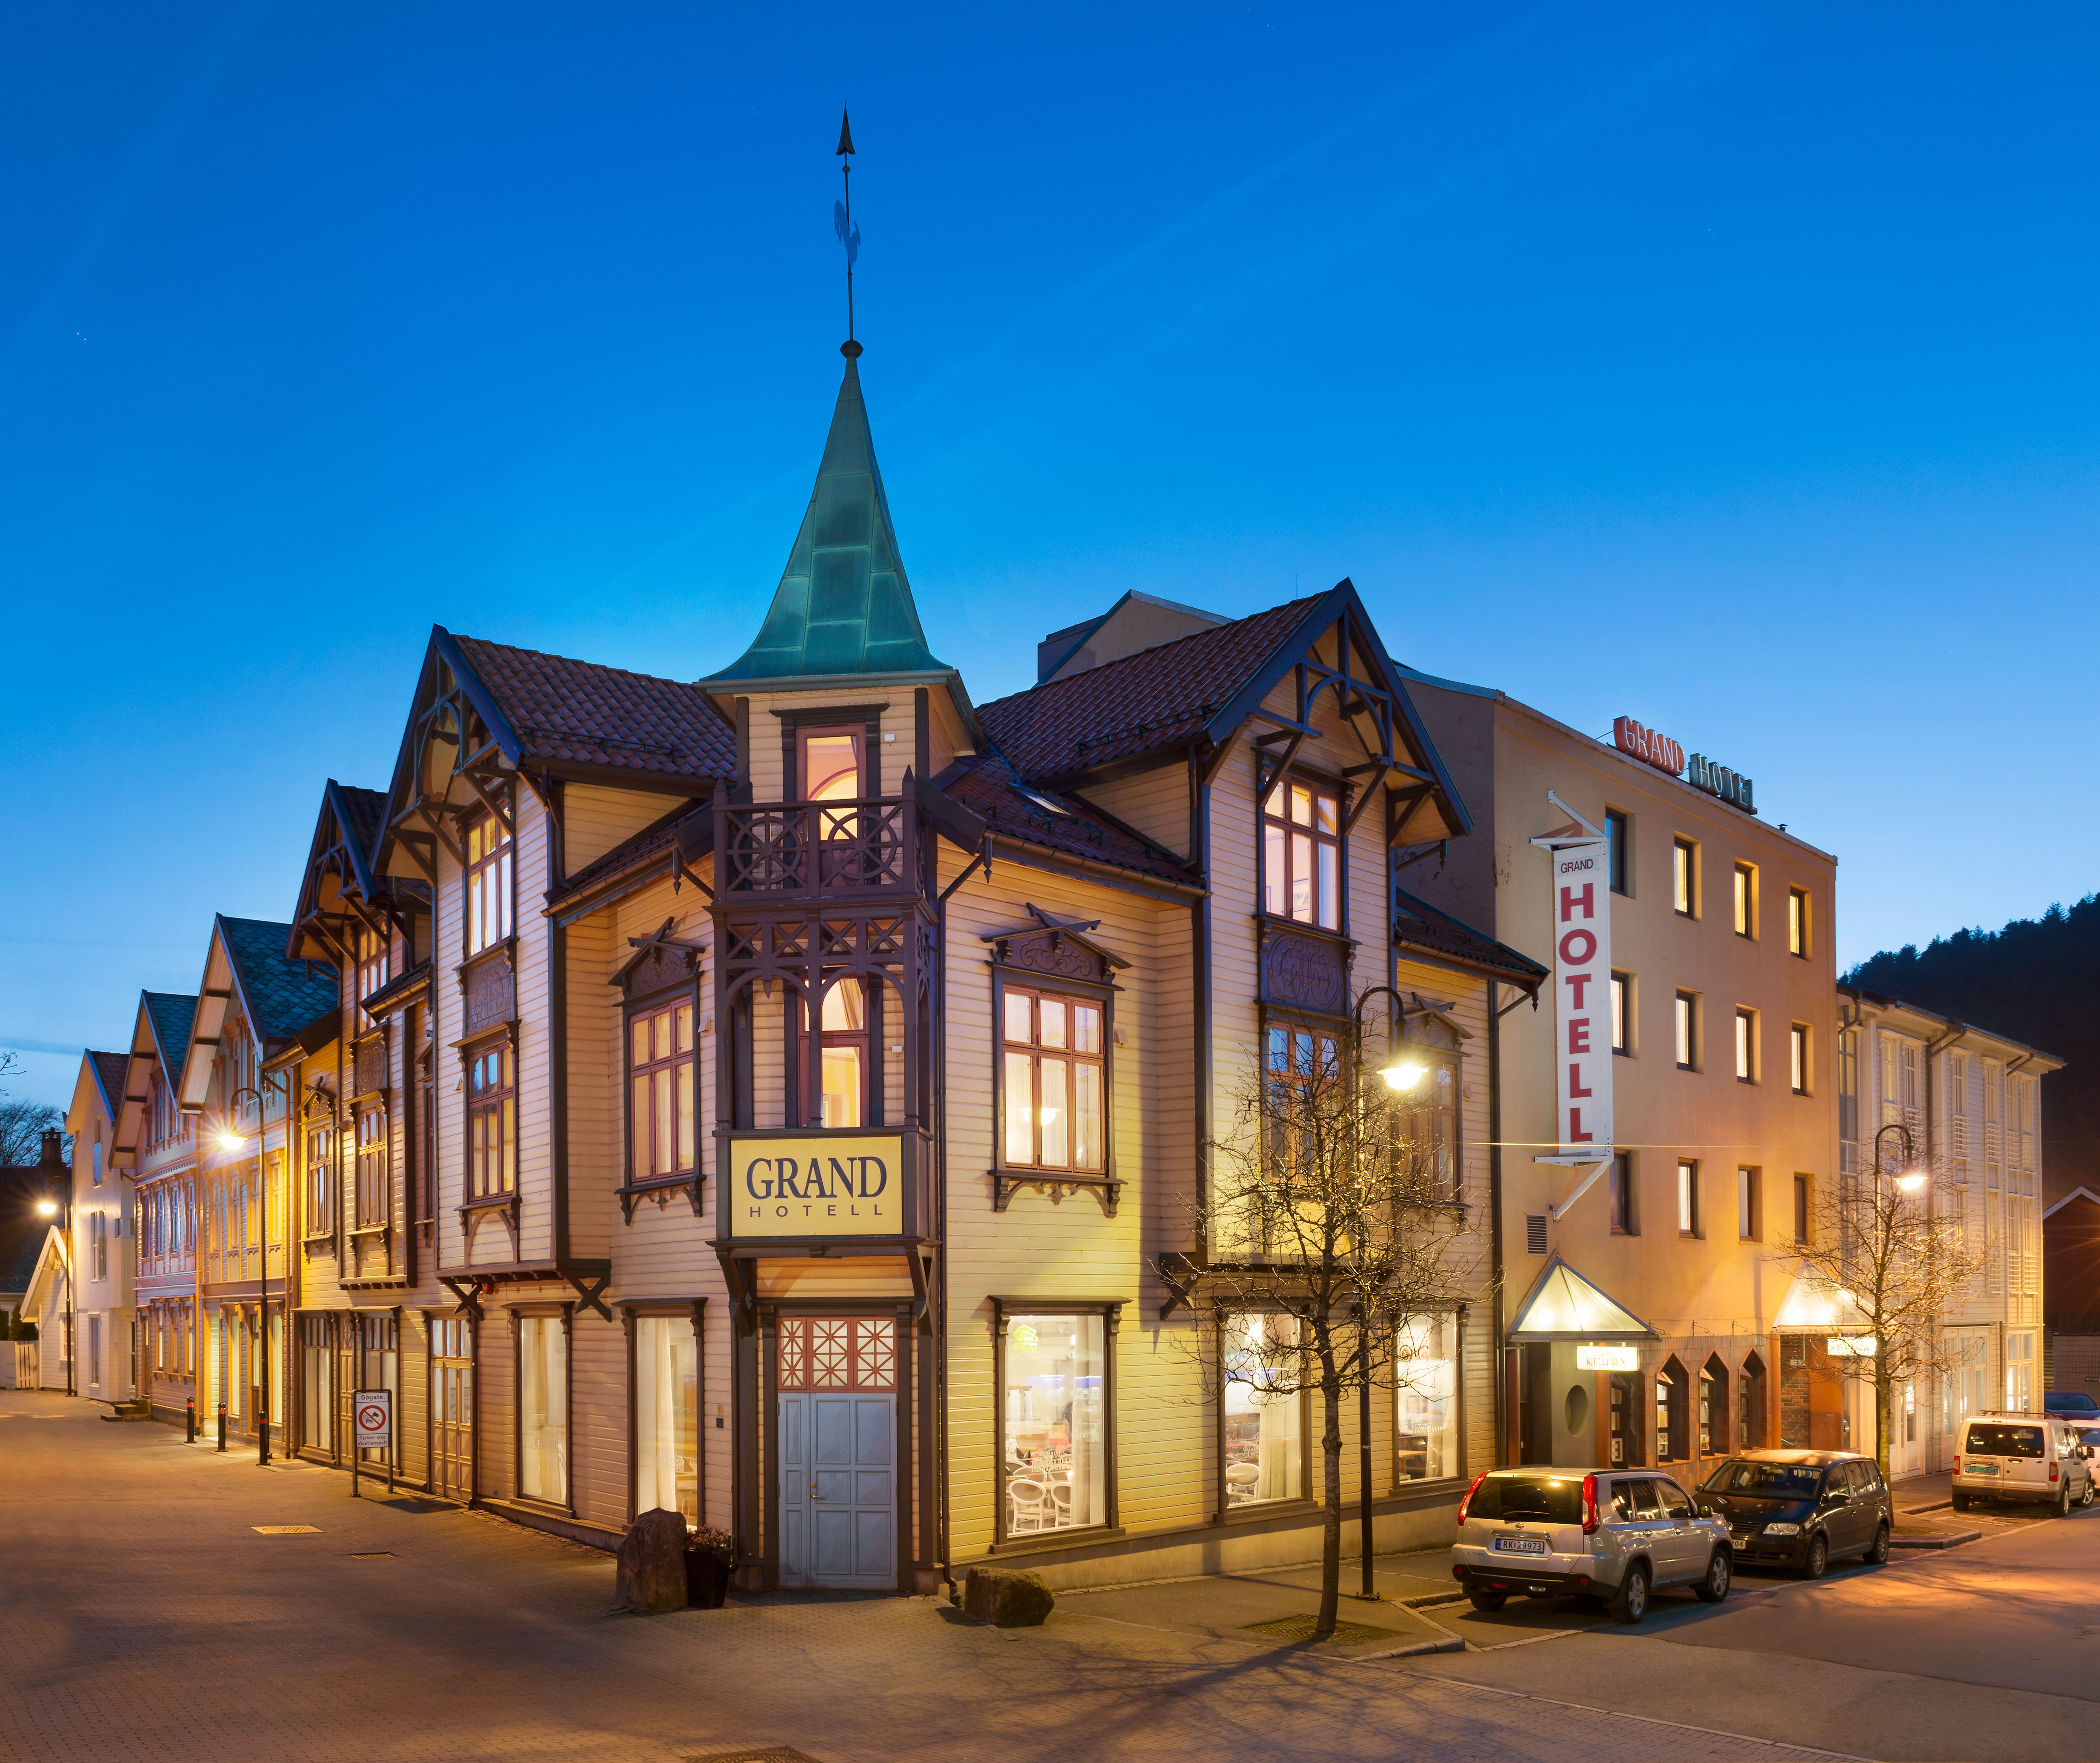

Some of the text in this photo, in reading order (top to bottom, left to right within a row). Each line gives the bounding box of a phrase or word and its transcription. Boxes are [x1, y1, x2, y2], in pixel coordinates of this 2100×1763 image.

[1614, 716, 1757, 814] GRAND HOTEL
[1560, 858, 1594, 873] GRAND
[1559, 882, 1597, 1143] HOTELL
[746, 1156, 887, 1200] GRAND
[750, 1204, 882, 1217] HOTELL
[1586, 1357, 1626, 1366] KJELLEREN
[1517, 1542, 1541, 1550] 29973
